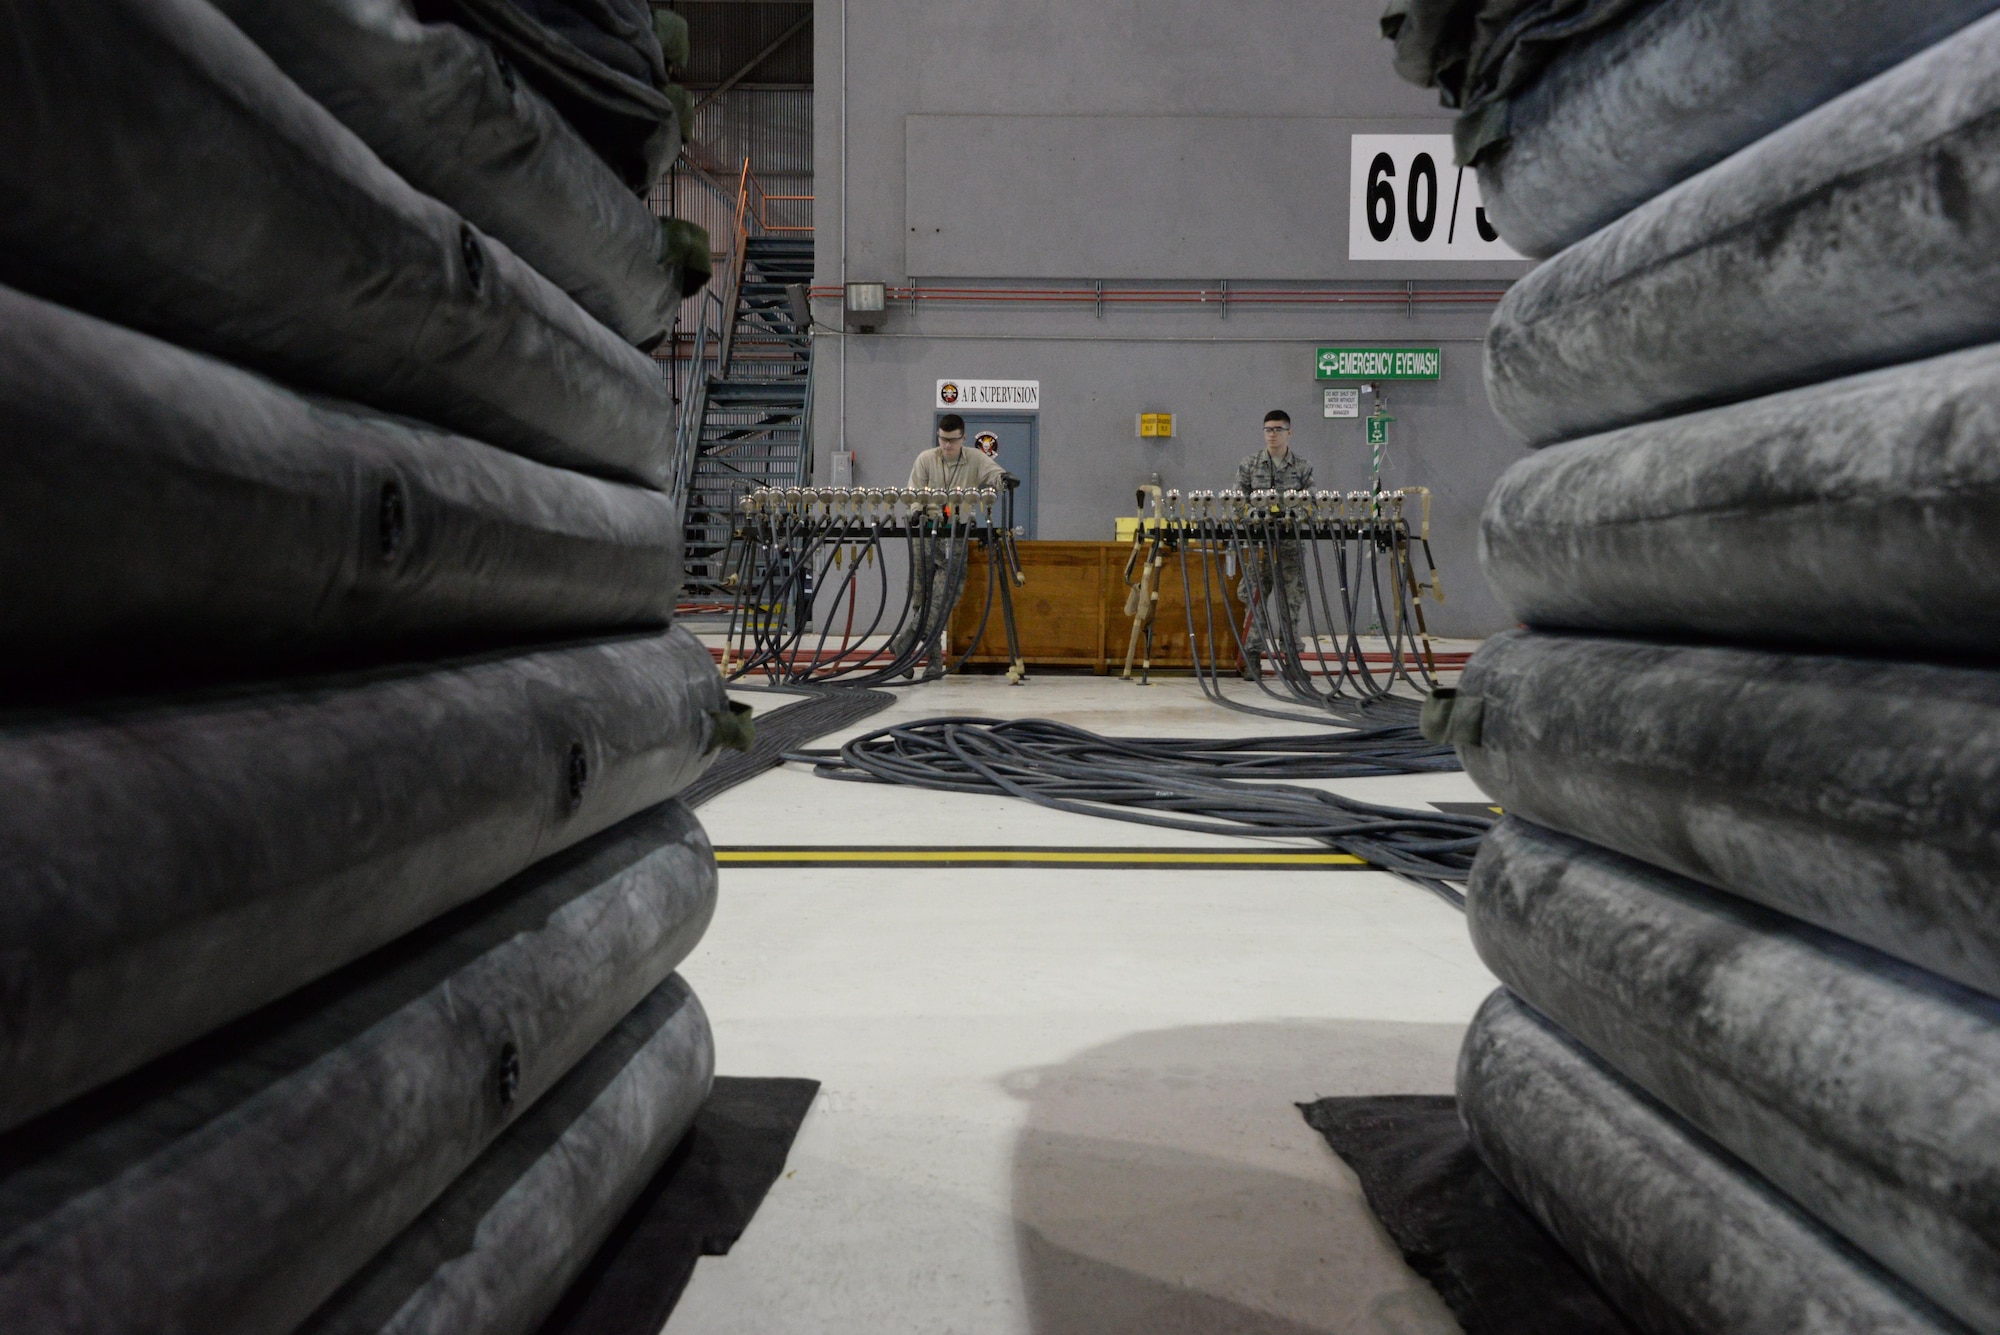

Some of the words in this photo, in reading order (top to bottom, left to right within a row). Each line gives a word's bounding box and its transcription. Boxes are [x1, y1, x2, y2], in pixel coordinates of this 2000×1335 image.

[1339, 352, 1393, 375] EMERGENCY
[1396, 352, 1438, 375] EYEWASH
[961, 386, 977, 403] A/R
[980, 386, 1038, 403] SUPERVISION
